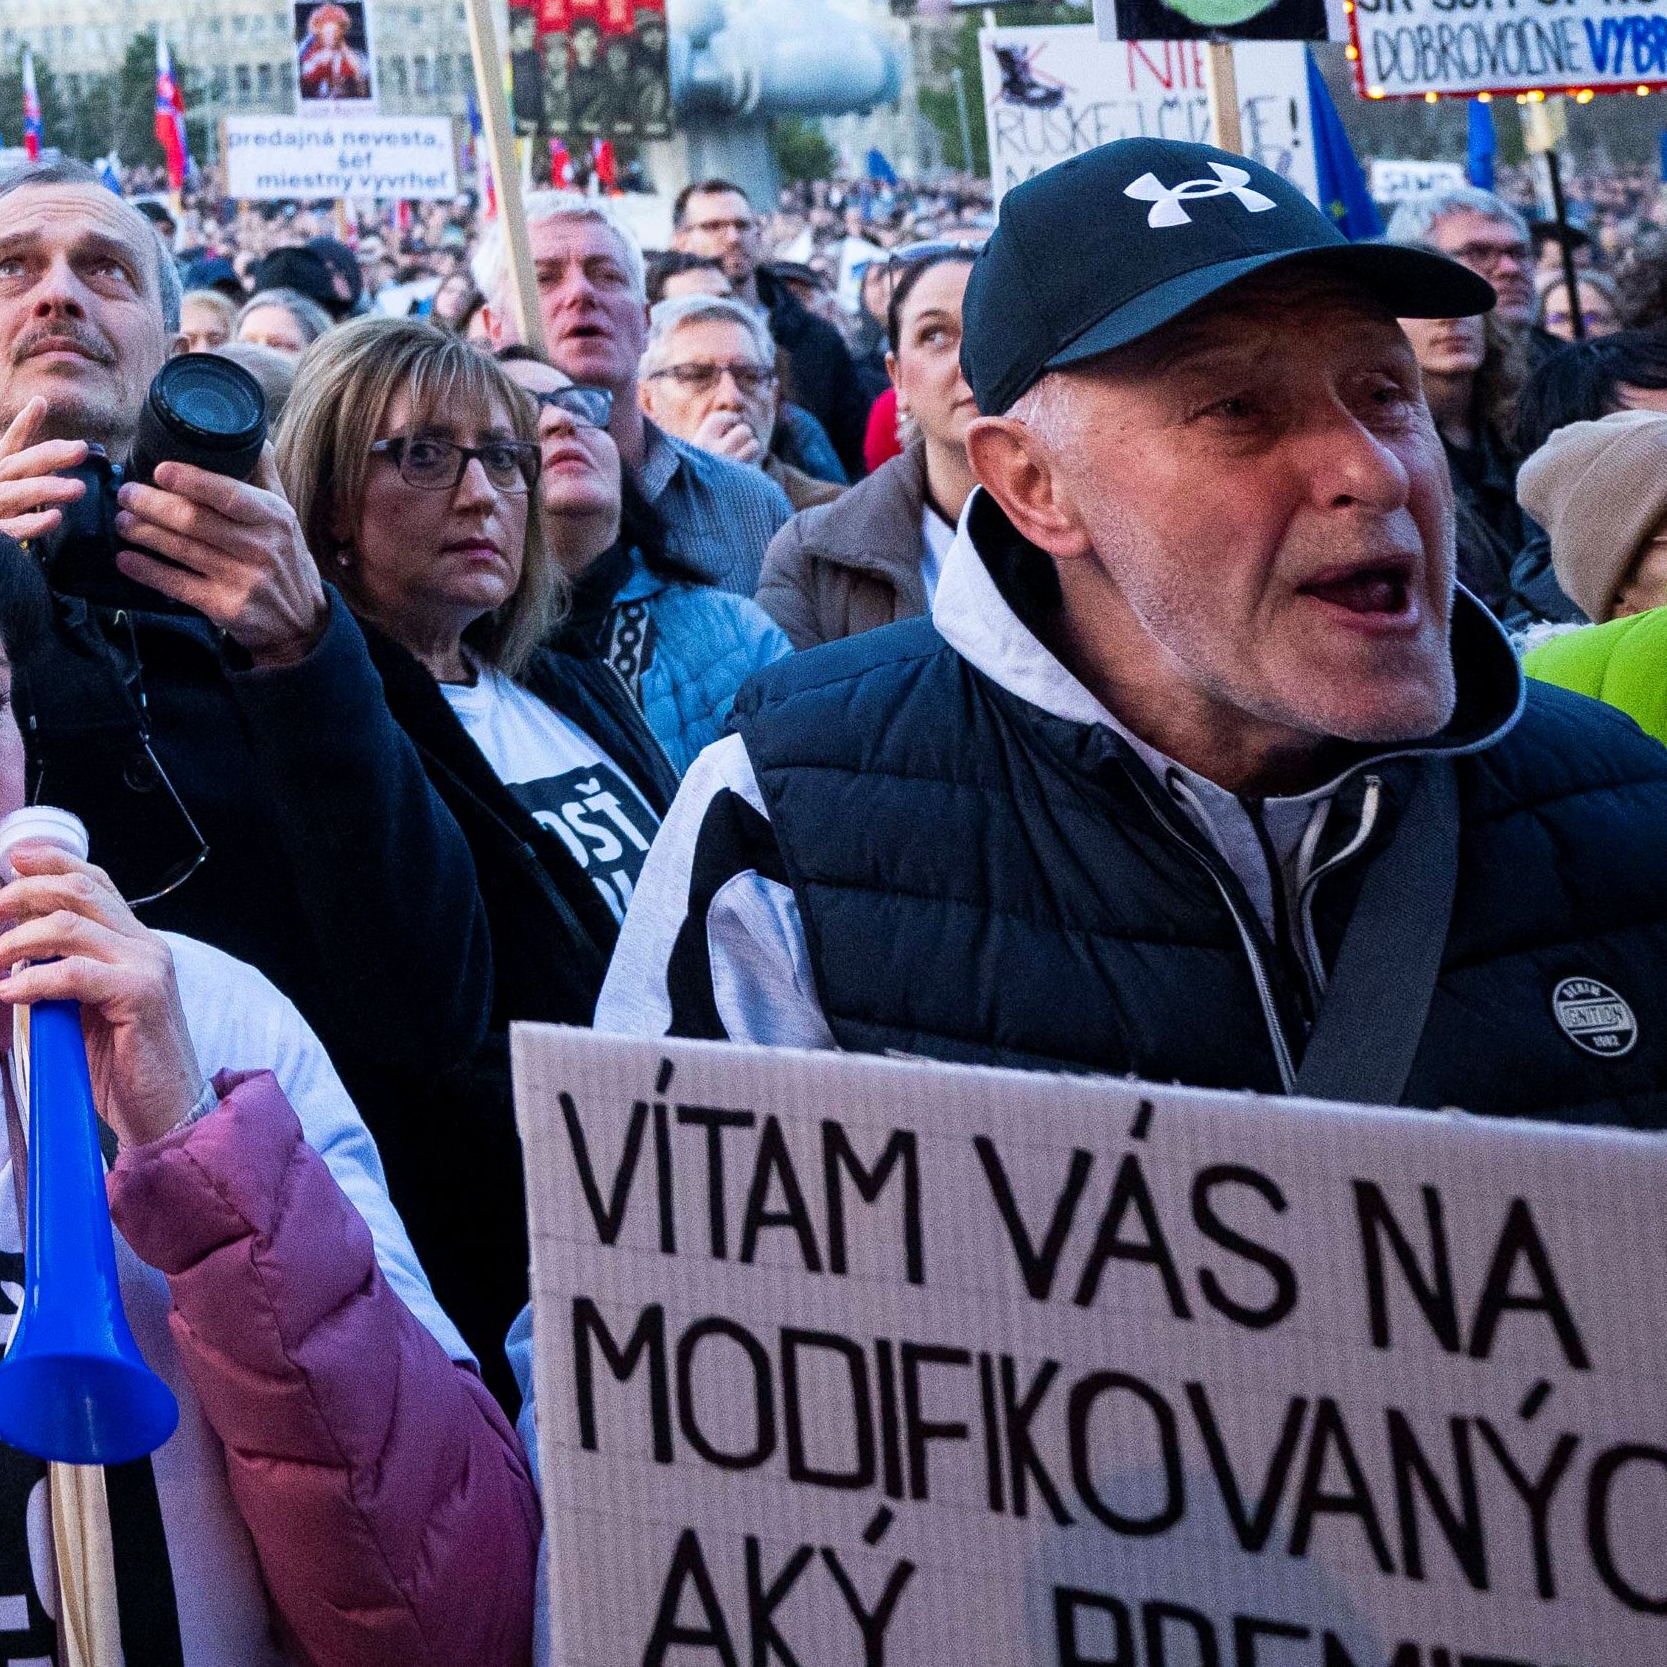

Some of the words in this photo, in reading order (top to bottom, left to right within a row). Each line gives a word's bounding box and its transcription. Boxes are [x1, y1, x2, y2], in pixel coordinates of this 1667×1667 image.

[558, 1060, 924, 1285] VÍTAM
[975, 1101, 1299, 1328] VÁS
[1353, 1179, 1589, 1370] NA
[642, 1505, 917, 1667] AKÝ
